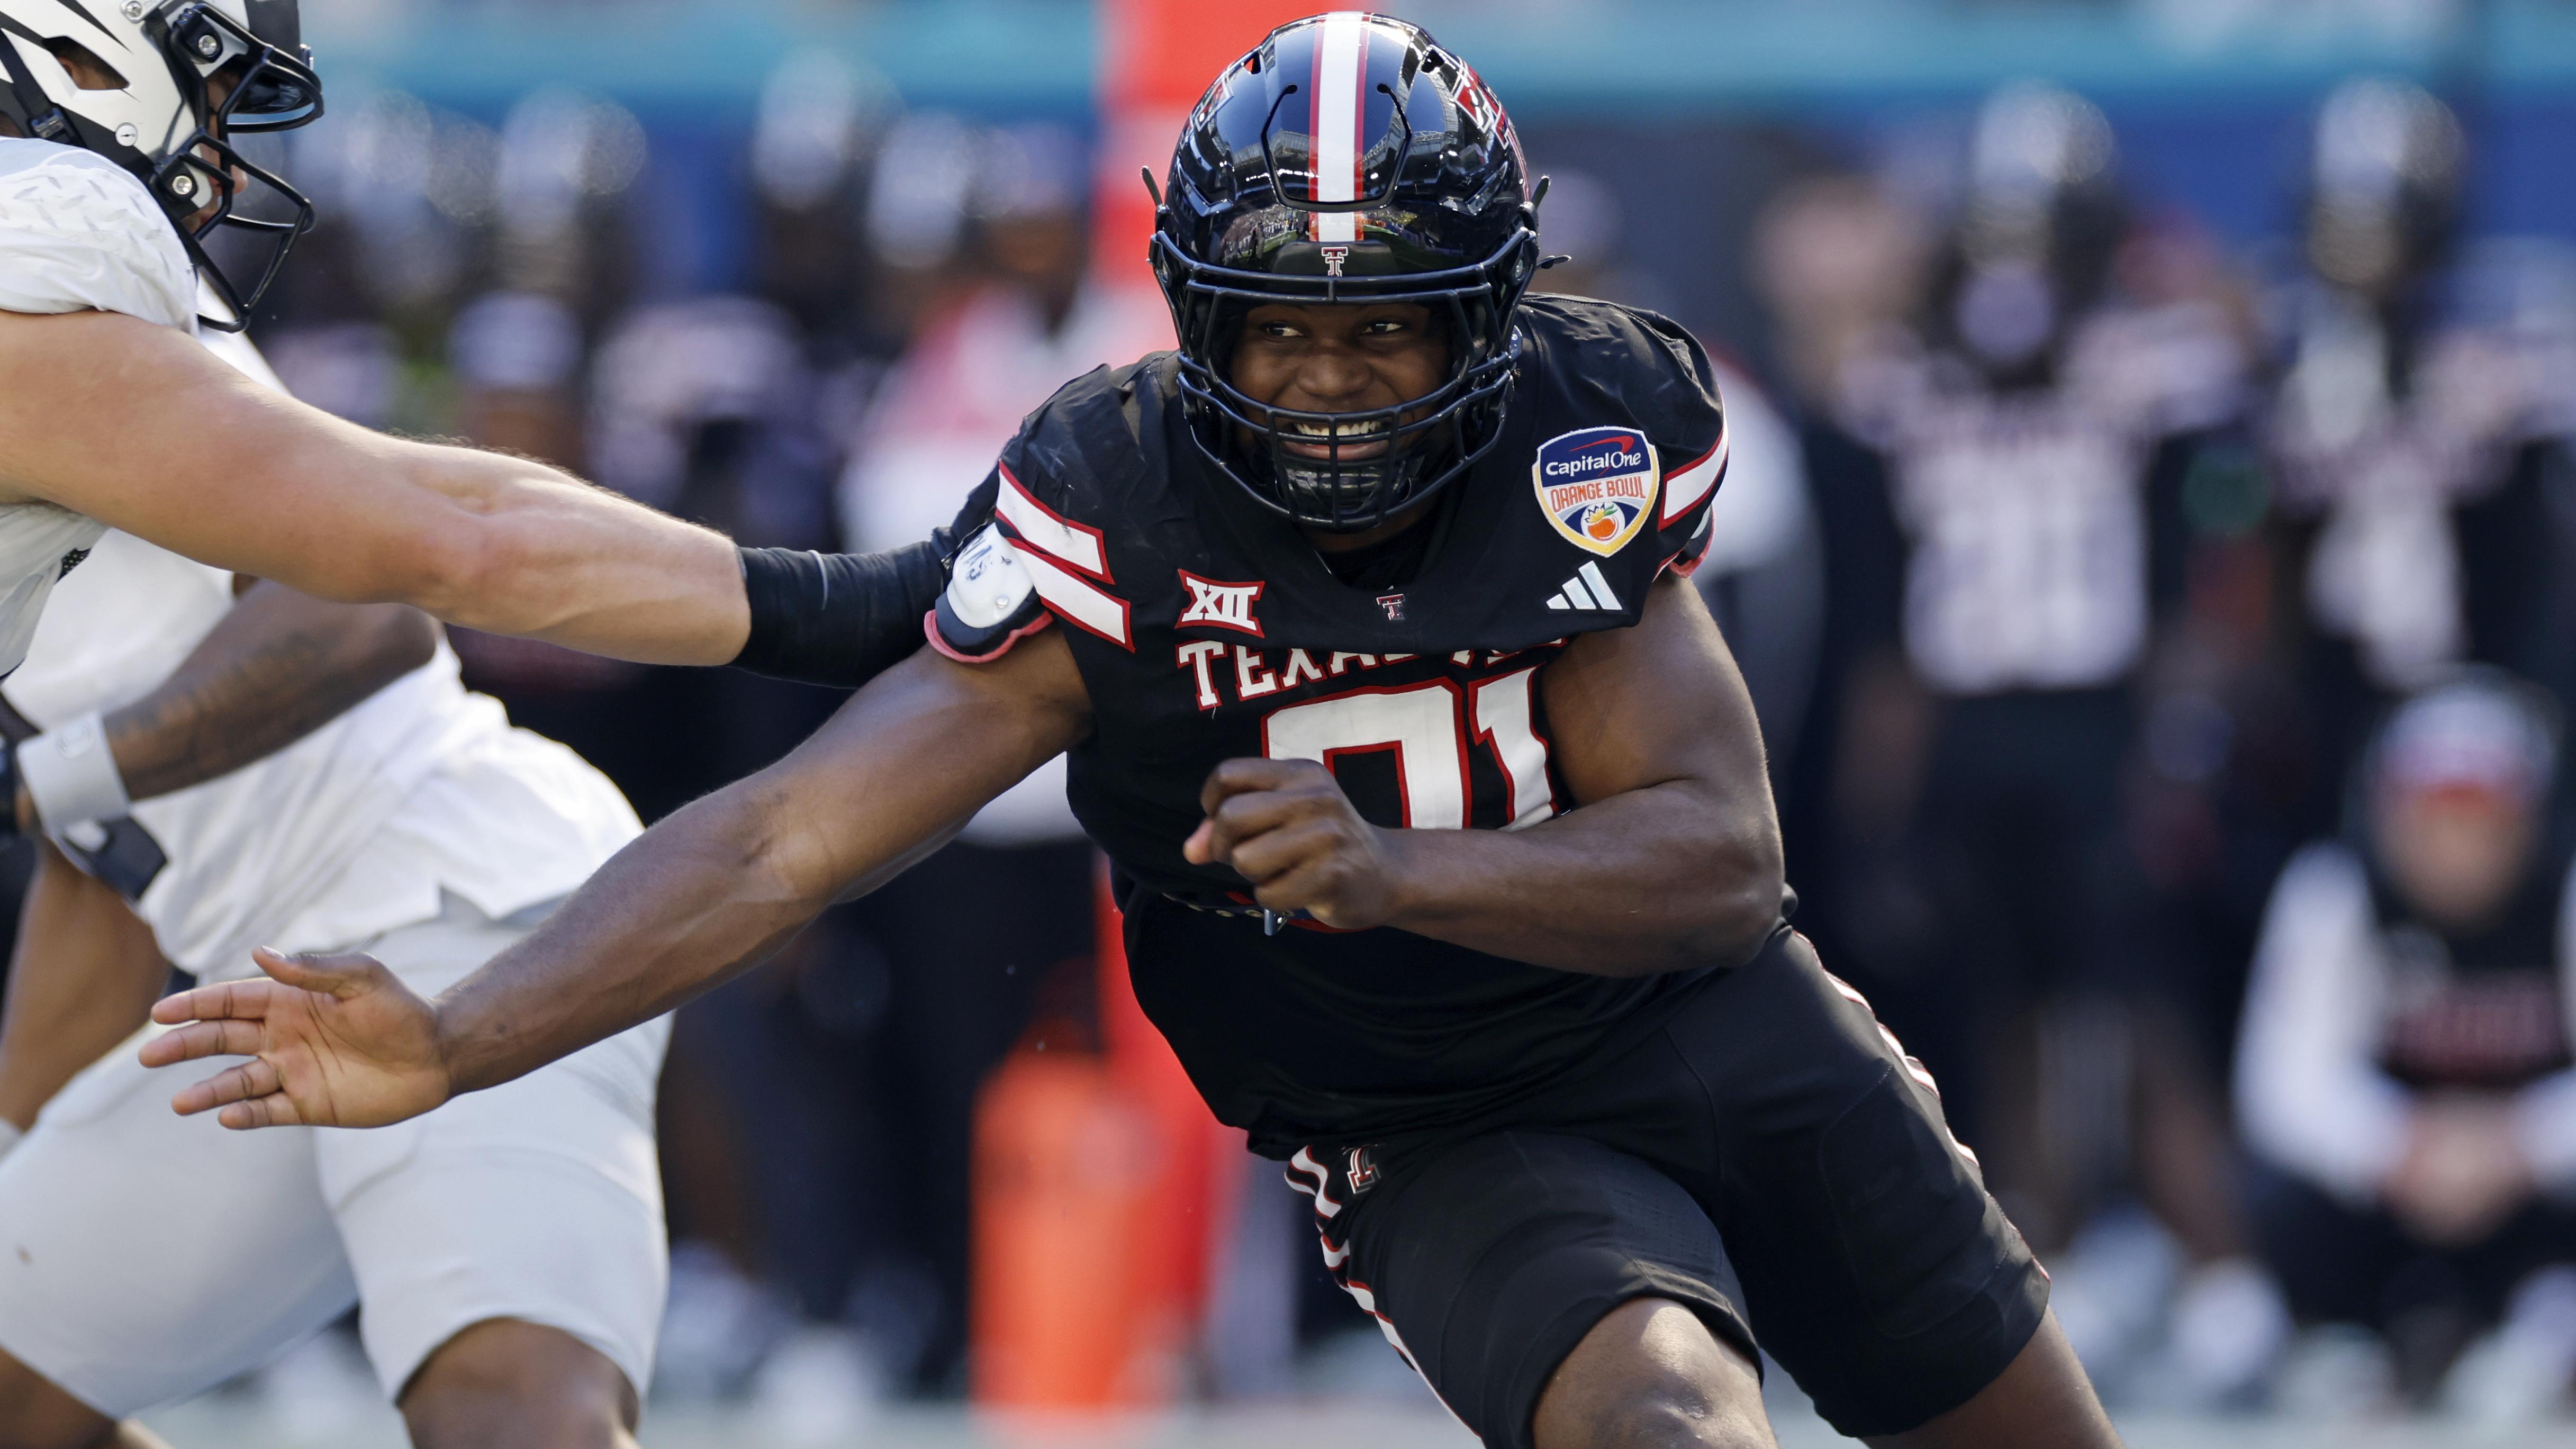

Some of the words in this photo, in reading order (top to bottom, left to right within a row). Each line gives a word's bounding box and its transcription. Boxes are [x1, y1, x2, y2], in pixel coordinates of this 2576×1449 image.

[1550, 482, 1604, 513] ORANGE
[1606, 476, 1647, 499] BOWL
[1180, 575, 1259, 632] XII
[1176, 639, 1420, 710] TEX
